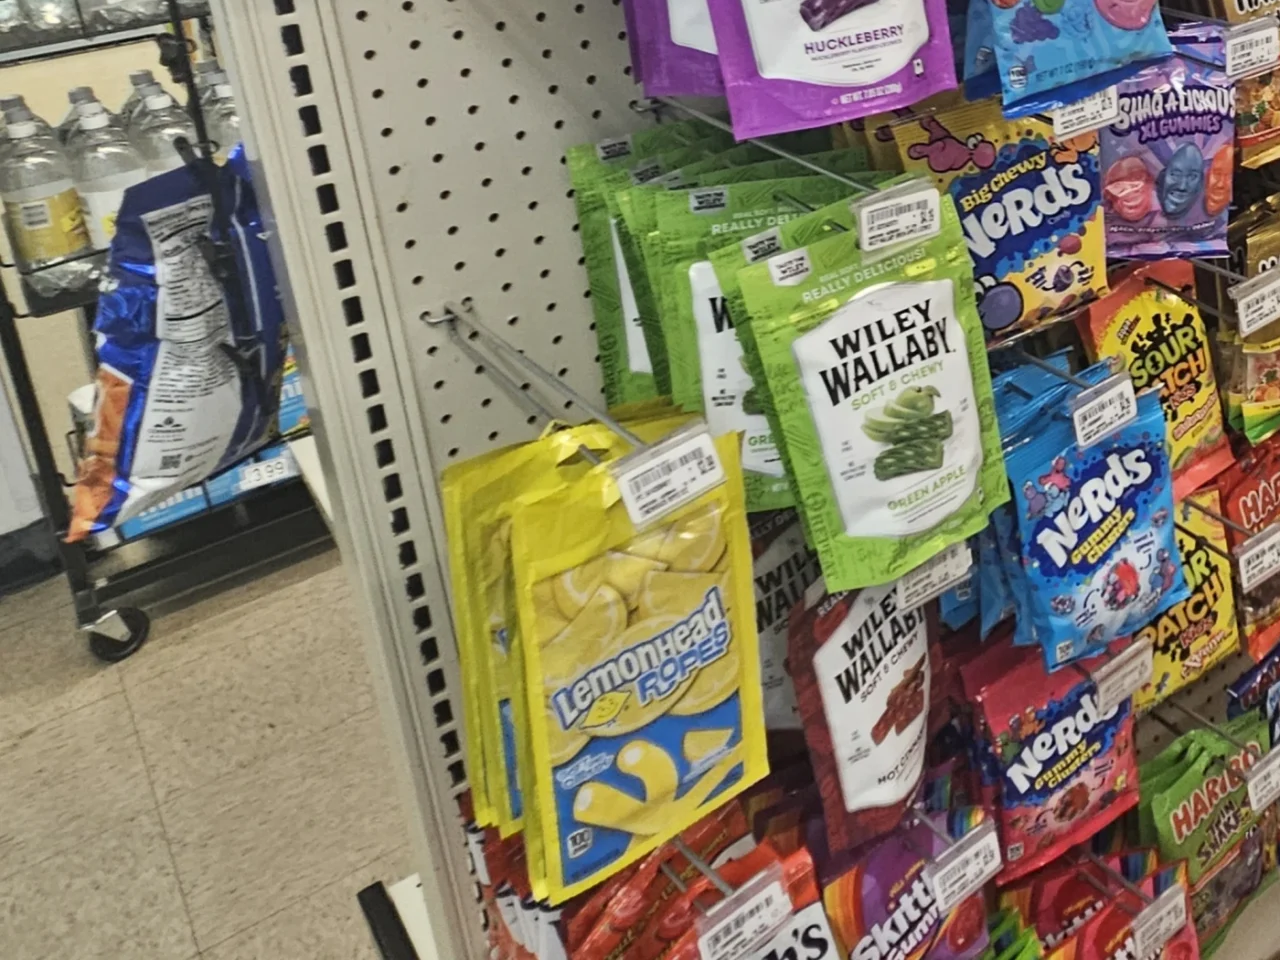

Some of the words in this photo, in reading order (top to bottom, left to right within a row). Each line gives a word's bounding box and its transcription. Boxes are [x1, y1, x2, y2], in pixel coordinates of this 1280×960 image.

[803, 24, 906, 56] HUCKLEBERRY
[1140, 121, 1158, 142] XL
[1160, 115, 1222, 136] GUMMIES
[711, 218, 763, 237] REALLY
[802, 279, 852, 304] REALLY
[853, 246, 927, 285] DELICIOUS!
[828, 298, 933, 361] WILEY
[1130, 325, 1198, 389] SOUR
[819, 315, 957, 408] WALLABY
[850, 384, 888, 411] SOFT
[888, 379, 898, 392] &
[900, 359, 945, 386] CHEWY
[748, 435, 775, 447] GRE
[886, 486, 931, 512] GREEN
[930, 465, 968, 495] APPLE
[1133, 578, 1226, 647] PATCH
[636, 619, 732, 707] ROPES
[859, 668, 884, 704] SOFT
[889, 632, 921, 670] CHEWY
[876, 765, 902, 787] HOT
[1170, 740, 1263, 845] HARIBO
